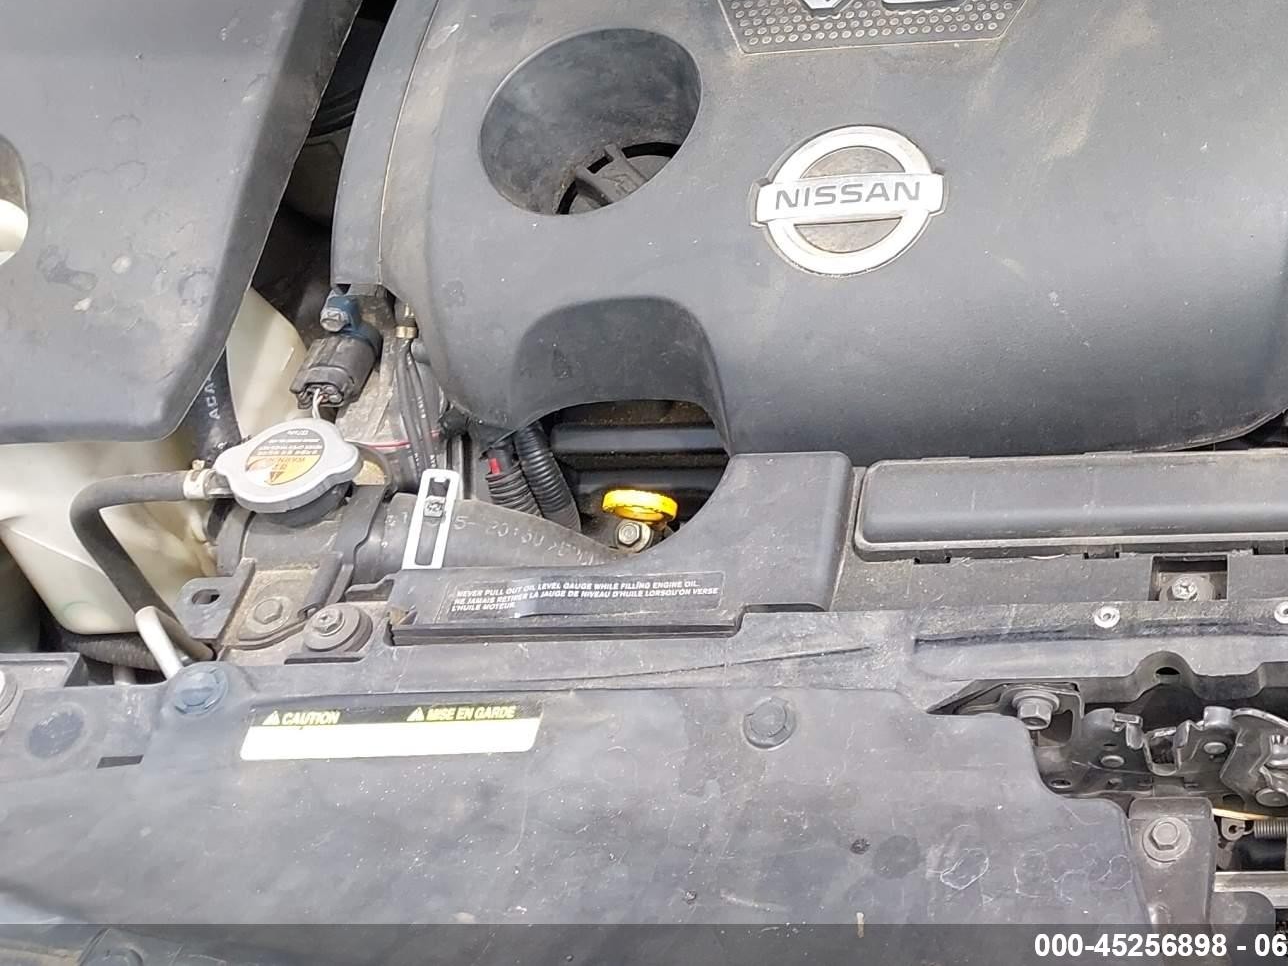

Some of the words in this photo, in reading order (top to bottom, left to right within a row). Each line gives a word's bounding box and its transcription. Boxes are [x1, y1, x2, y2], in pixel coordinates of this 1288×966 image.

[775, 181, 921, 211] NISSAN
[454, 597, 465, 605] NE
[467, 596, 495, 604] JAMAIS
[497, 593, 528, 603] RETIRER
[540, 590, 566, 598] JAUGE
[581, 590, 610, 598] NIVEAU
[612, 589, 644, 597] D'HUILE
[645, 588, 691, 597] LORSQU'ON
[693, 587, 719, 595] VERSE
[456, 589, 483, 598] NEVER
[484, 588, 504, 597] PULL
[506, 586, 522, 595] OUT
[523, 584, 536, 593] OIL
[538, 582, 561, 591] LEVEL
[563, 582, 592, 590] GAUGE
[593, 582, 619, 590] WHILE
[620, 580, 650, 590] FILLING
[652, 581, 683, 589] ENGINE
[451, 603, 480, 612] L'HUILE
[281, 711, 341, 725] CAUTION
[426, 707, 454, 721] MISE
[455, 707, 474, 721] EN
[474, 705, 517, 720] GARDE
